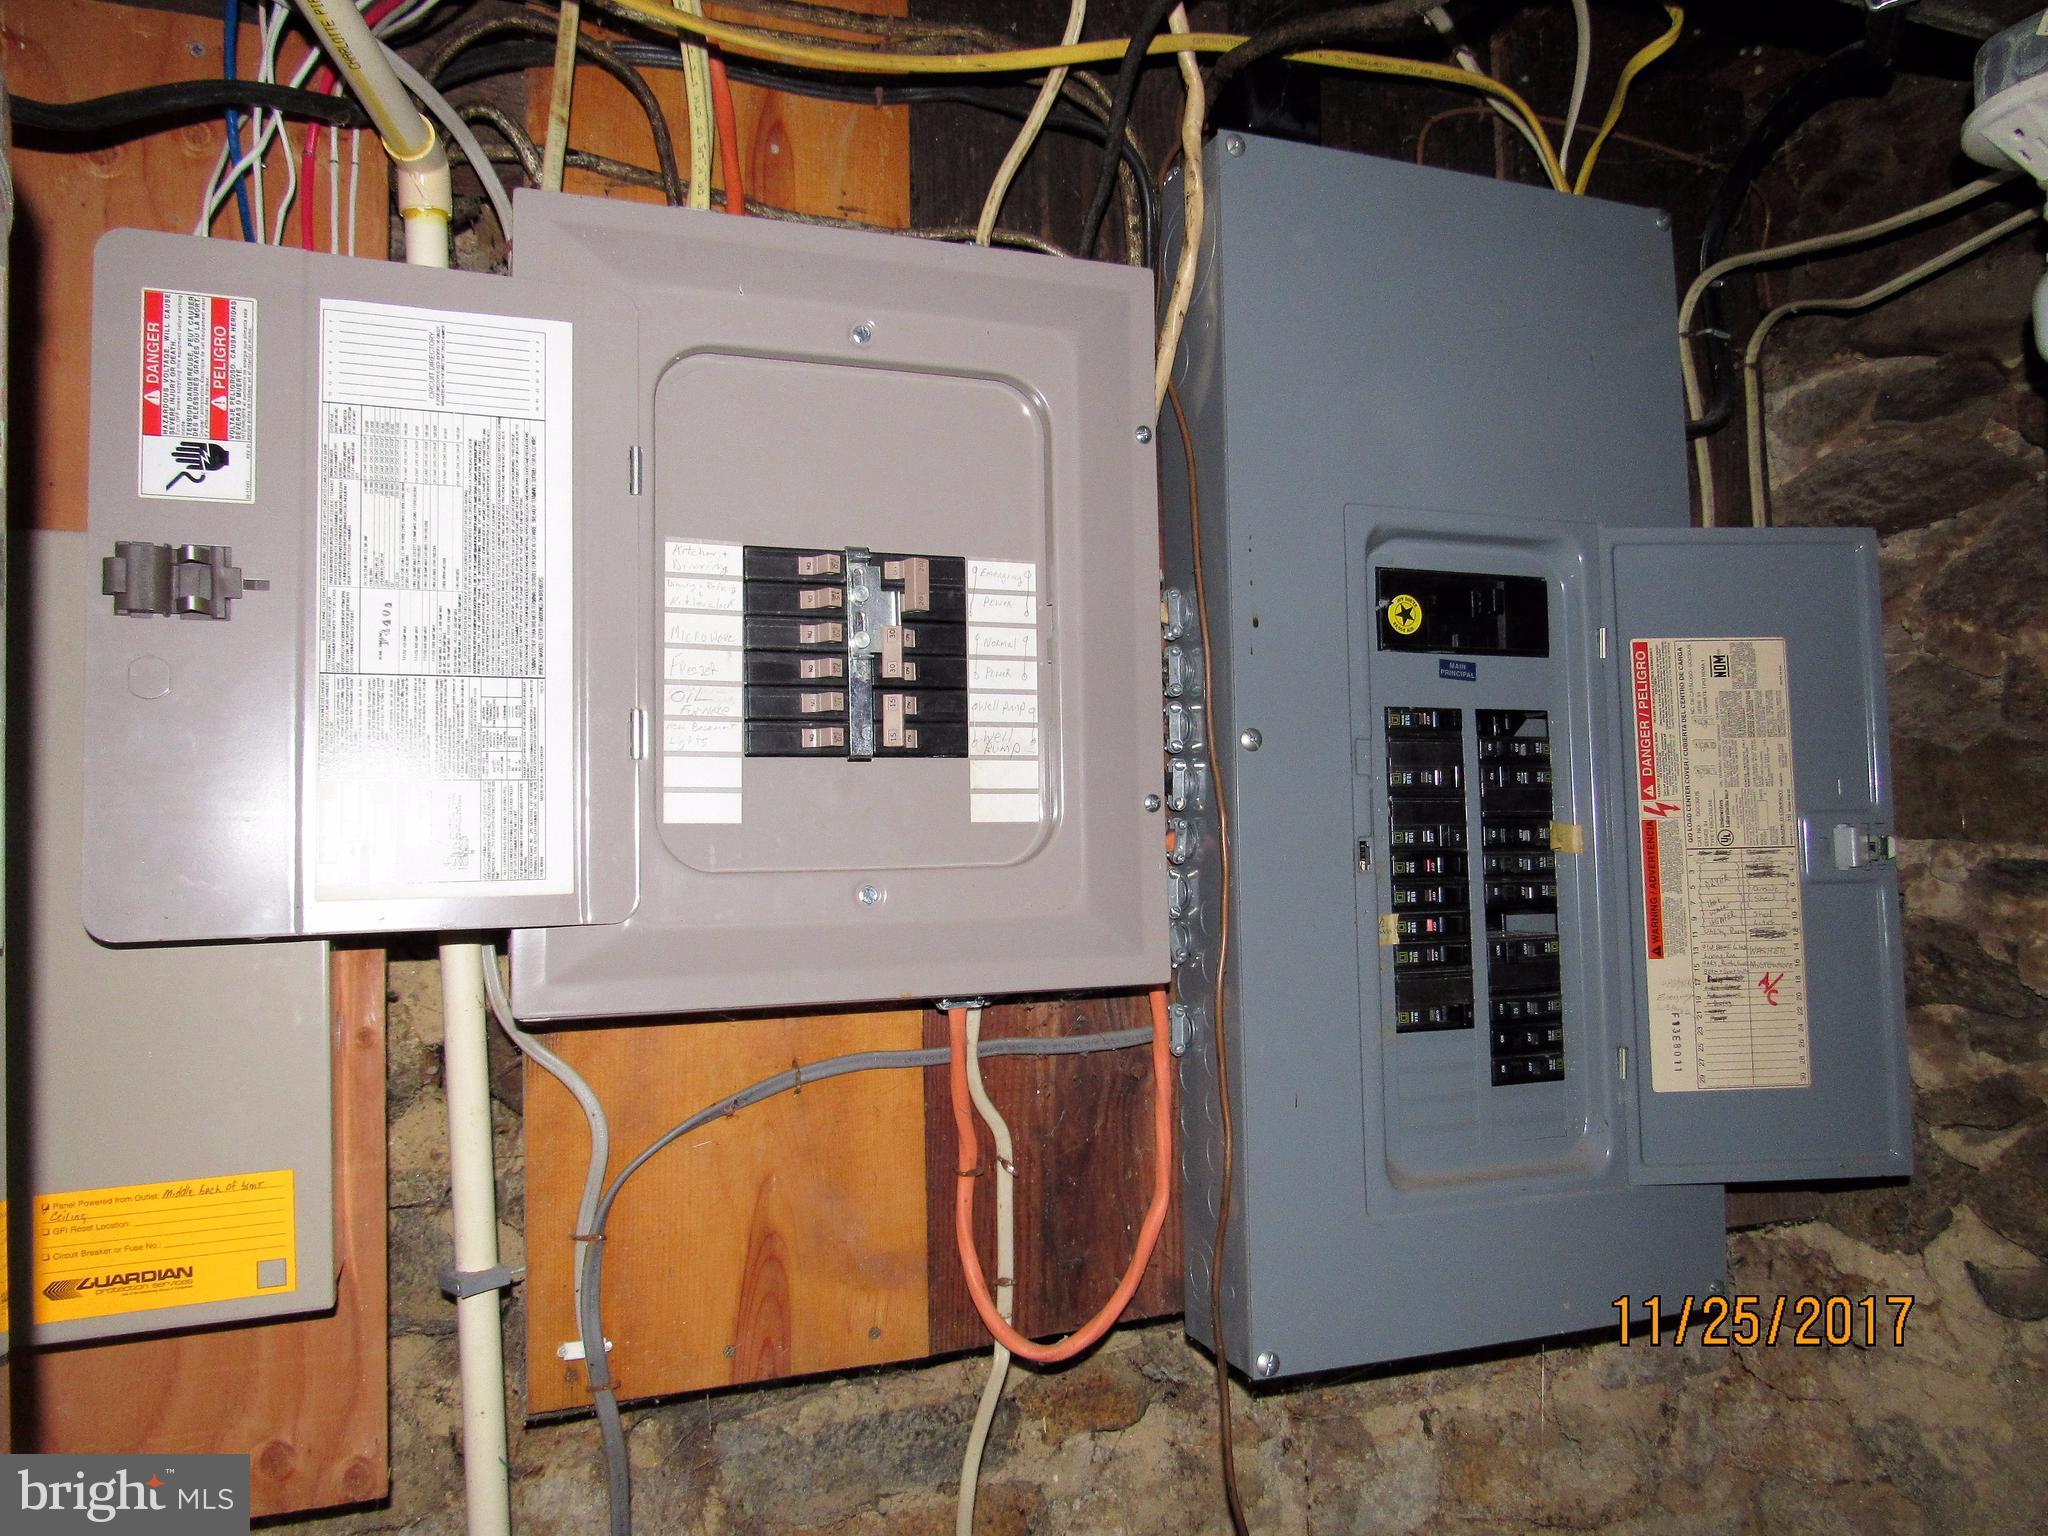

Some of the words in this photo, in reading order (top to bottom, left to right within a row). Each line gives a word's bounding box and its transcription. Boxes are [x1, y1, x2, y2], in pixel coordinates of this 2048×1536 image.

[320, 20, 361, 70] CHARLOTTE
[194, 321, 199, 330] LA
[194, 333, 199, 343] OU
[146, 322, 159, 384] DANGER
[214, 326, 227, 388] PELIGRO
[170, 367, 175, 376] OR
[807, 562, 811, 570] ON
[808, 595, 812, 603] ON
[808, 630, 812, 638] ON
[889, 628, 895, 639] 30
[906, 633, 911, 641] ON
[808, 665, 813, 673] ON
[889, 663, 896, 673] 30
[906, 666, 911, 674] ON
[1449, 662, 1466, 670] MAIN
[1712, 655, 1727, 678] NOM
[1440, 669, 1474, 678] PRINCIPAL
[1678, 672, 1684, 681] DE
[1635, 650, 1649, 709] PELIGRO
[890, 697, 896, 708] 15
[906, 701, 911, 709] ON
[809, 733, 814, 742] ON
[890, 731, 897, 742] 15
[907, 734, 912, 742] ON
[1681, 724, 1689, 756] CUBIERTA
[1640, 721, 1652, 776] DANGER
[1720, 833, 1731, 843] UL
[1646, 821, 1658, 889] ADVERTENCIA
[1650, 897, 1661, 943] WARNING
[1749, 947, 1785, 955] WASHER
[1796, 992, 1802, 1000] 20
[1696, 1011, 1702, 1019] 21
[1798, 1007, 1803, 1015] 22
[1697, 1027, 1703, 1035] 23
[1798, 1024, 1803, 1032] 24
[1671, 1012, 1683, 1072] F13E8011
[1698, 1044, 1703, 1052] 25
[1698, 1059, 1704, 1067] 27
[1800, 1056, 1806, 1064] 28
[1699, 1075, 1705, 1083] 29
[1800, 1073, 1806, 1081] 30
[226, 1181, 236, 1191] of
[78, 1198, 112, 1206] Powered
[71, 1224, 93, 1232] Reset
[53, 1252, 78, 1260] Circuit
[81, 1248, 111, 1256] Breaker
[124, 1244, 143, 1252] Fuse
[76, 1266, 193, 1291] GUARDIAN
[95, 1283, 148, 1295] protection
[152, 1278, 191, 1288] services
